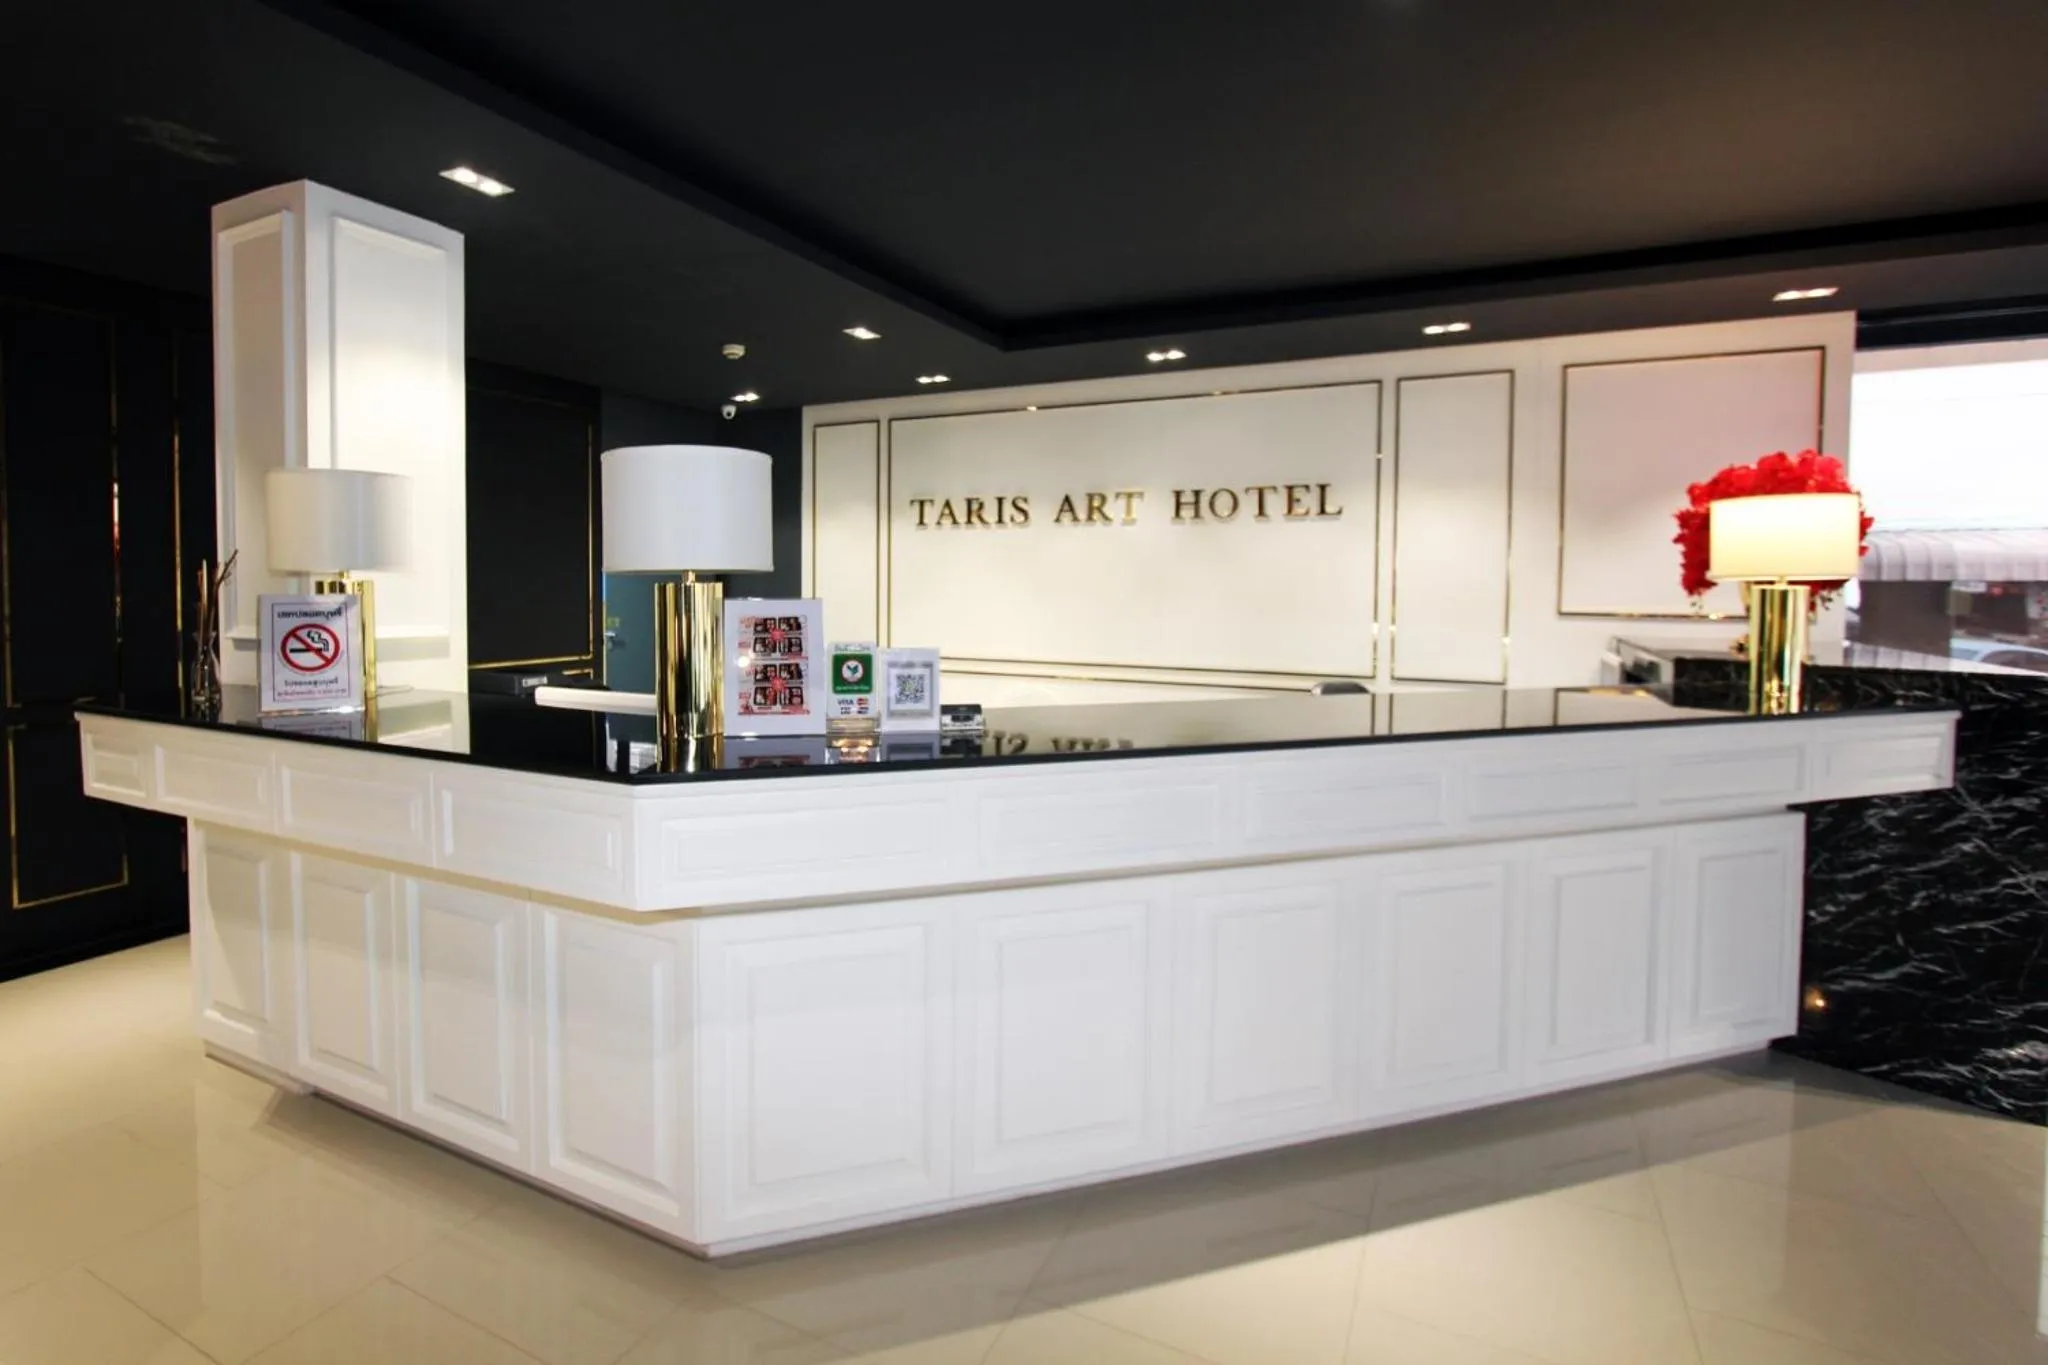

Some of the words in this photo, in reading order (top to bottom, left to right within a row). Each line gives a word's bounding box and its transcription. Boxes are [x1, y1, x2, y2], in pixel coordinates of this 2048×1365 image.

[910, 495, 1031, 527] TARIS
[1054, 491, 1145, 524] ART
[1172, 483, 1343, 520] HOTEL
